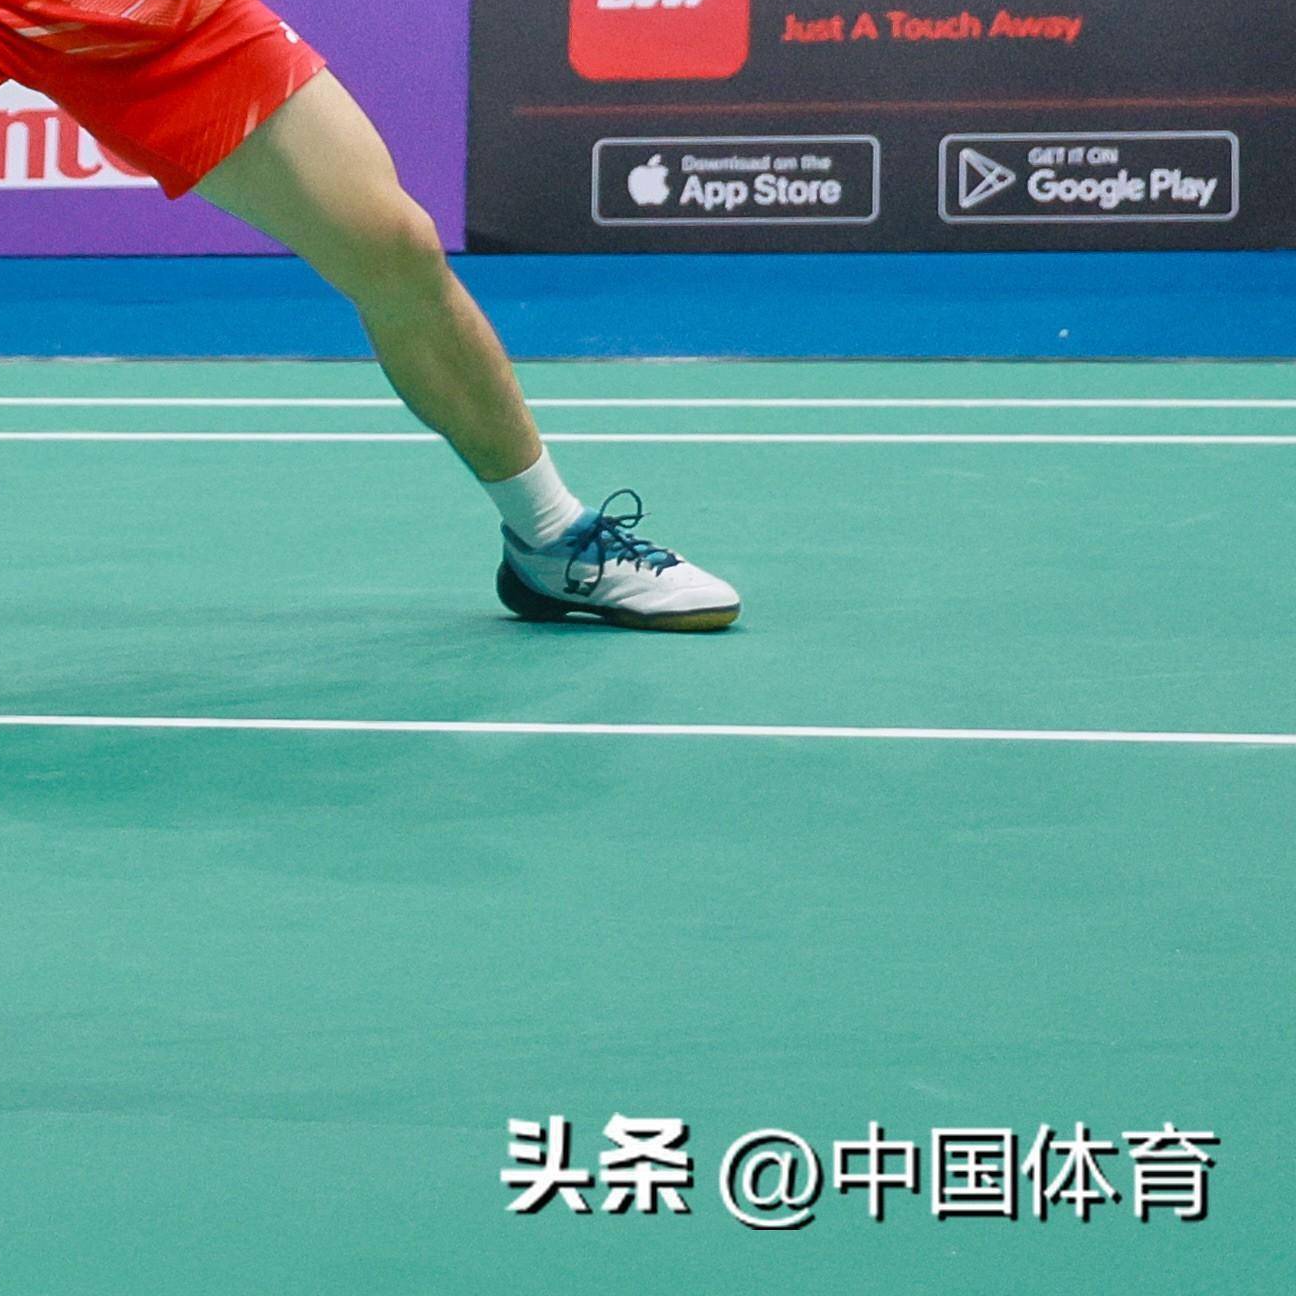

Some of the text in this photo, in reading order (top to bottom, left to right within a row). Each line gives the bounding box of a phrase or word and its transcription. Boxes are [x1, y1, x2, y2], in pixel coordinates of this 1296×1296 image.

[782, 9, 1084, 45] Just A Touch Away
[679, 172, 842, 212] App Store
[1027, 167, 1218, 210] Google Play
